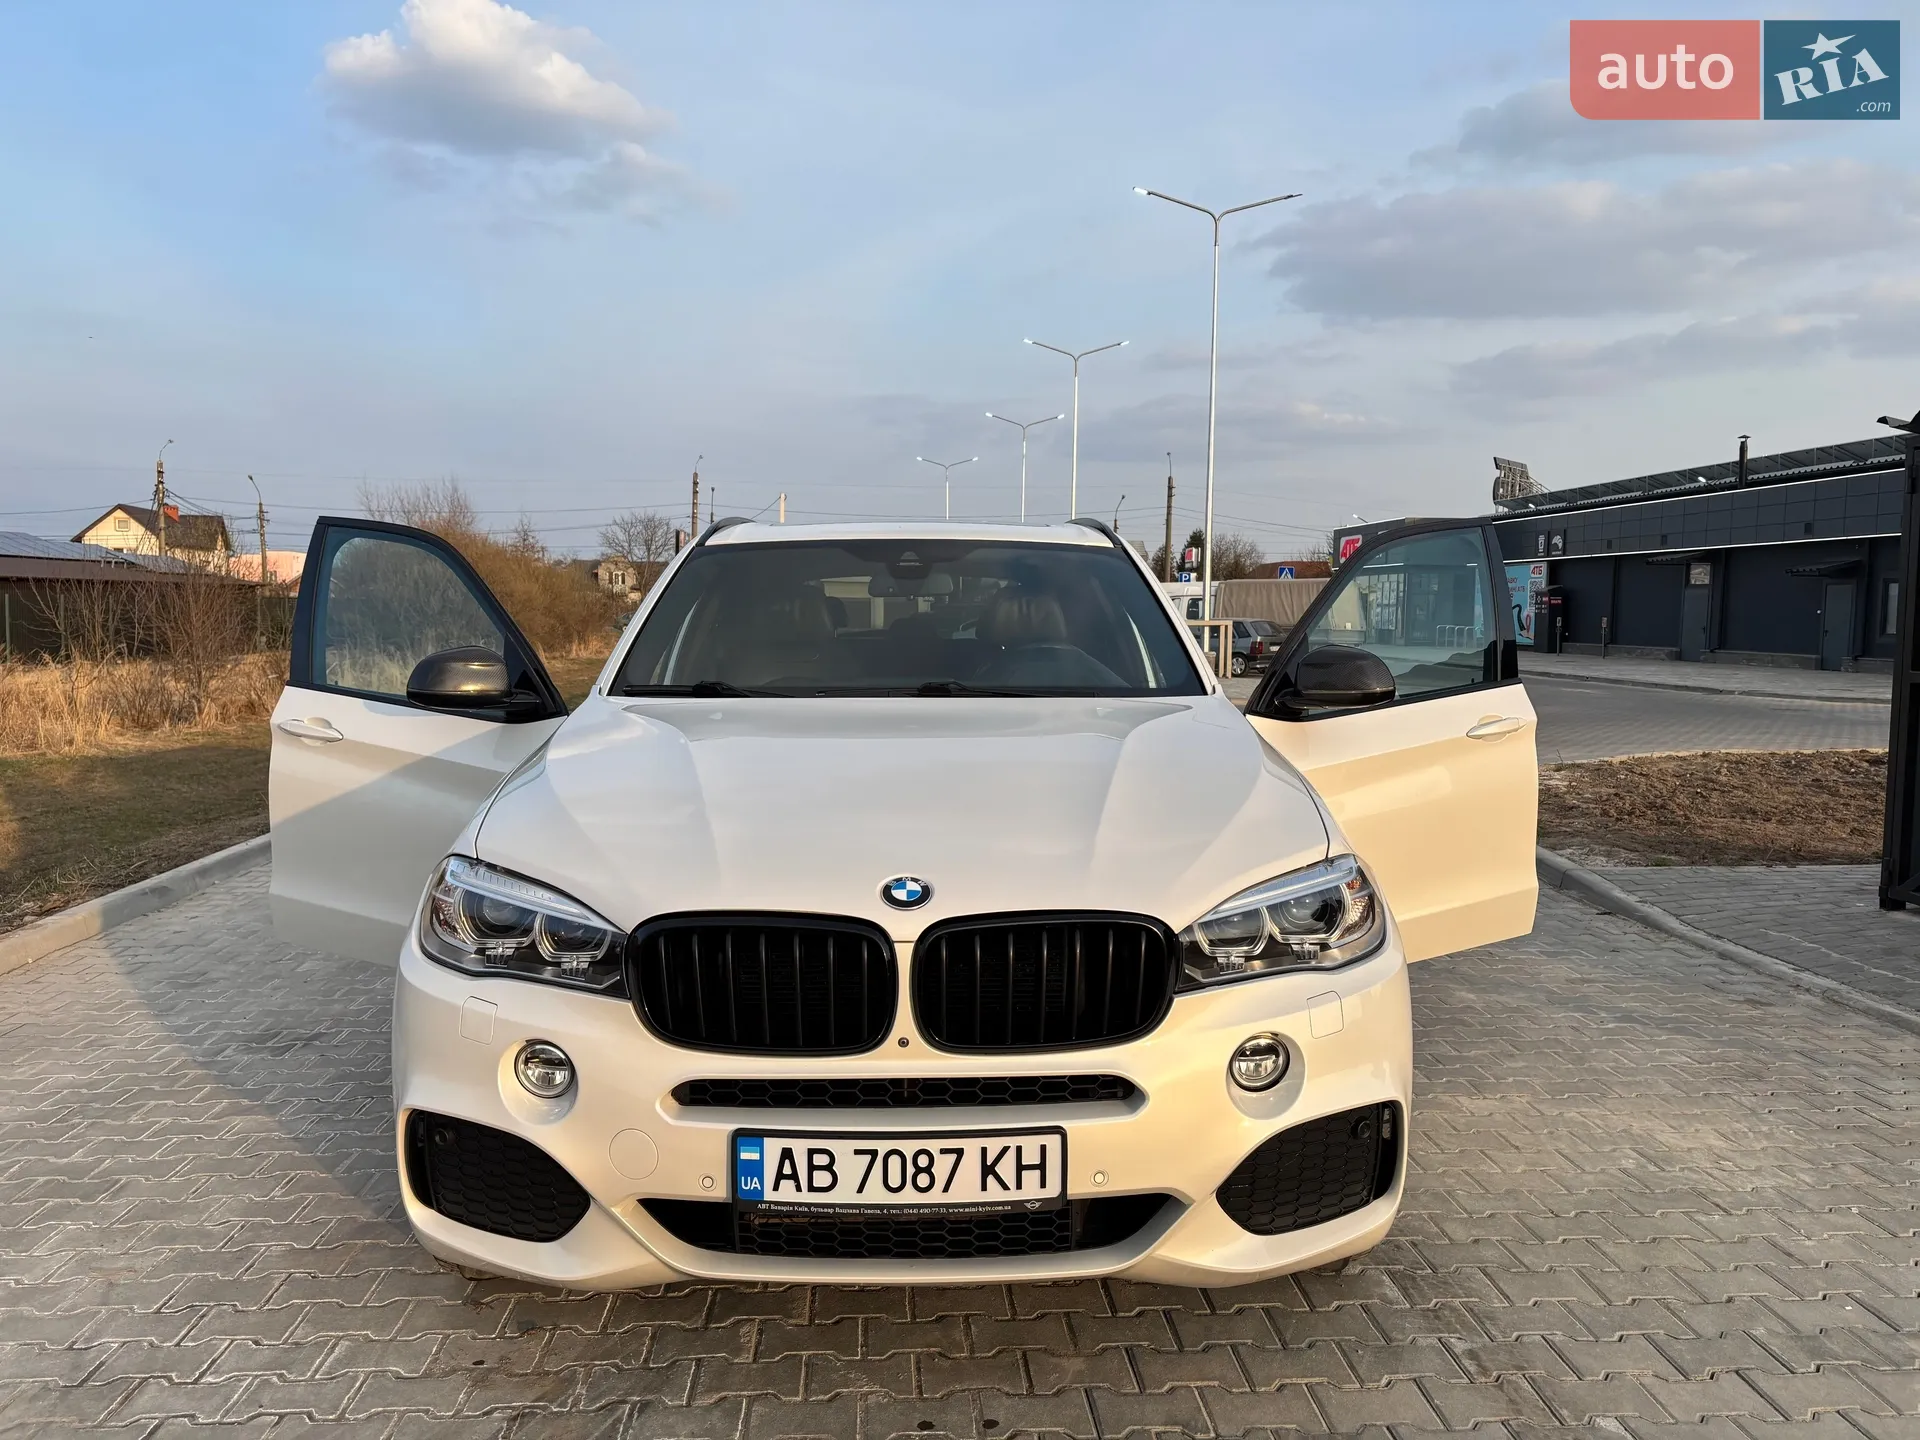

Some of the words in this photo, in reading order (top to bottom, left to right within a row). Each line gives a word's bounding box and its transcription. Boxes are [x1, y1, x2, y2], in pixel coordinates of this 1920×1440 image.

[1182, 573, 1190, 582] P
[772, 1147, 839, 1193] AB
[853, 1147, 965, 1194] 7087
[980, 1144, 1047, 1192] KH
[741, 1177, 761, 1190] UA
[948, 1205, 1012, 1213] www.mini-kyiv.com.ua
